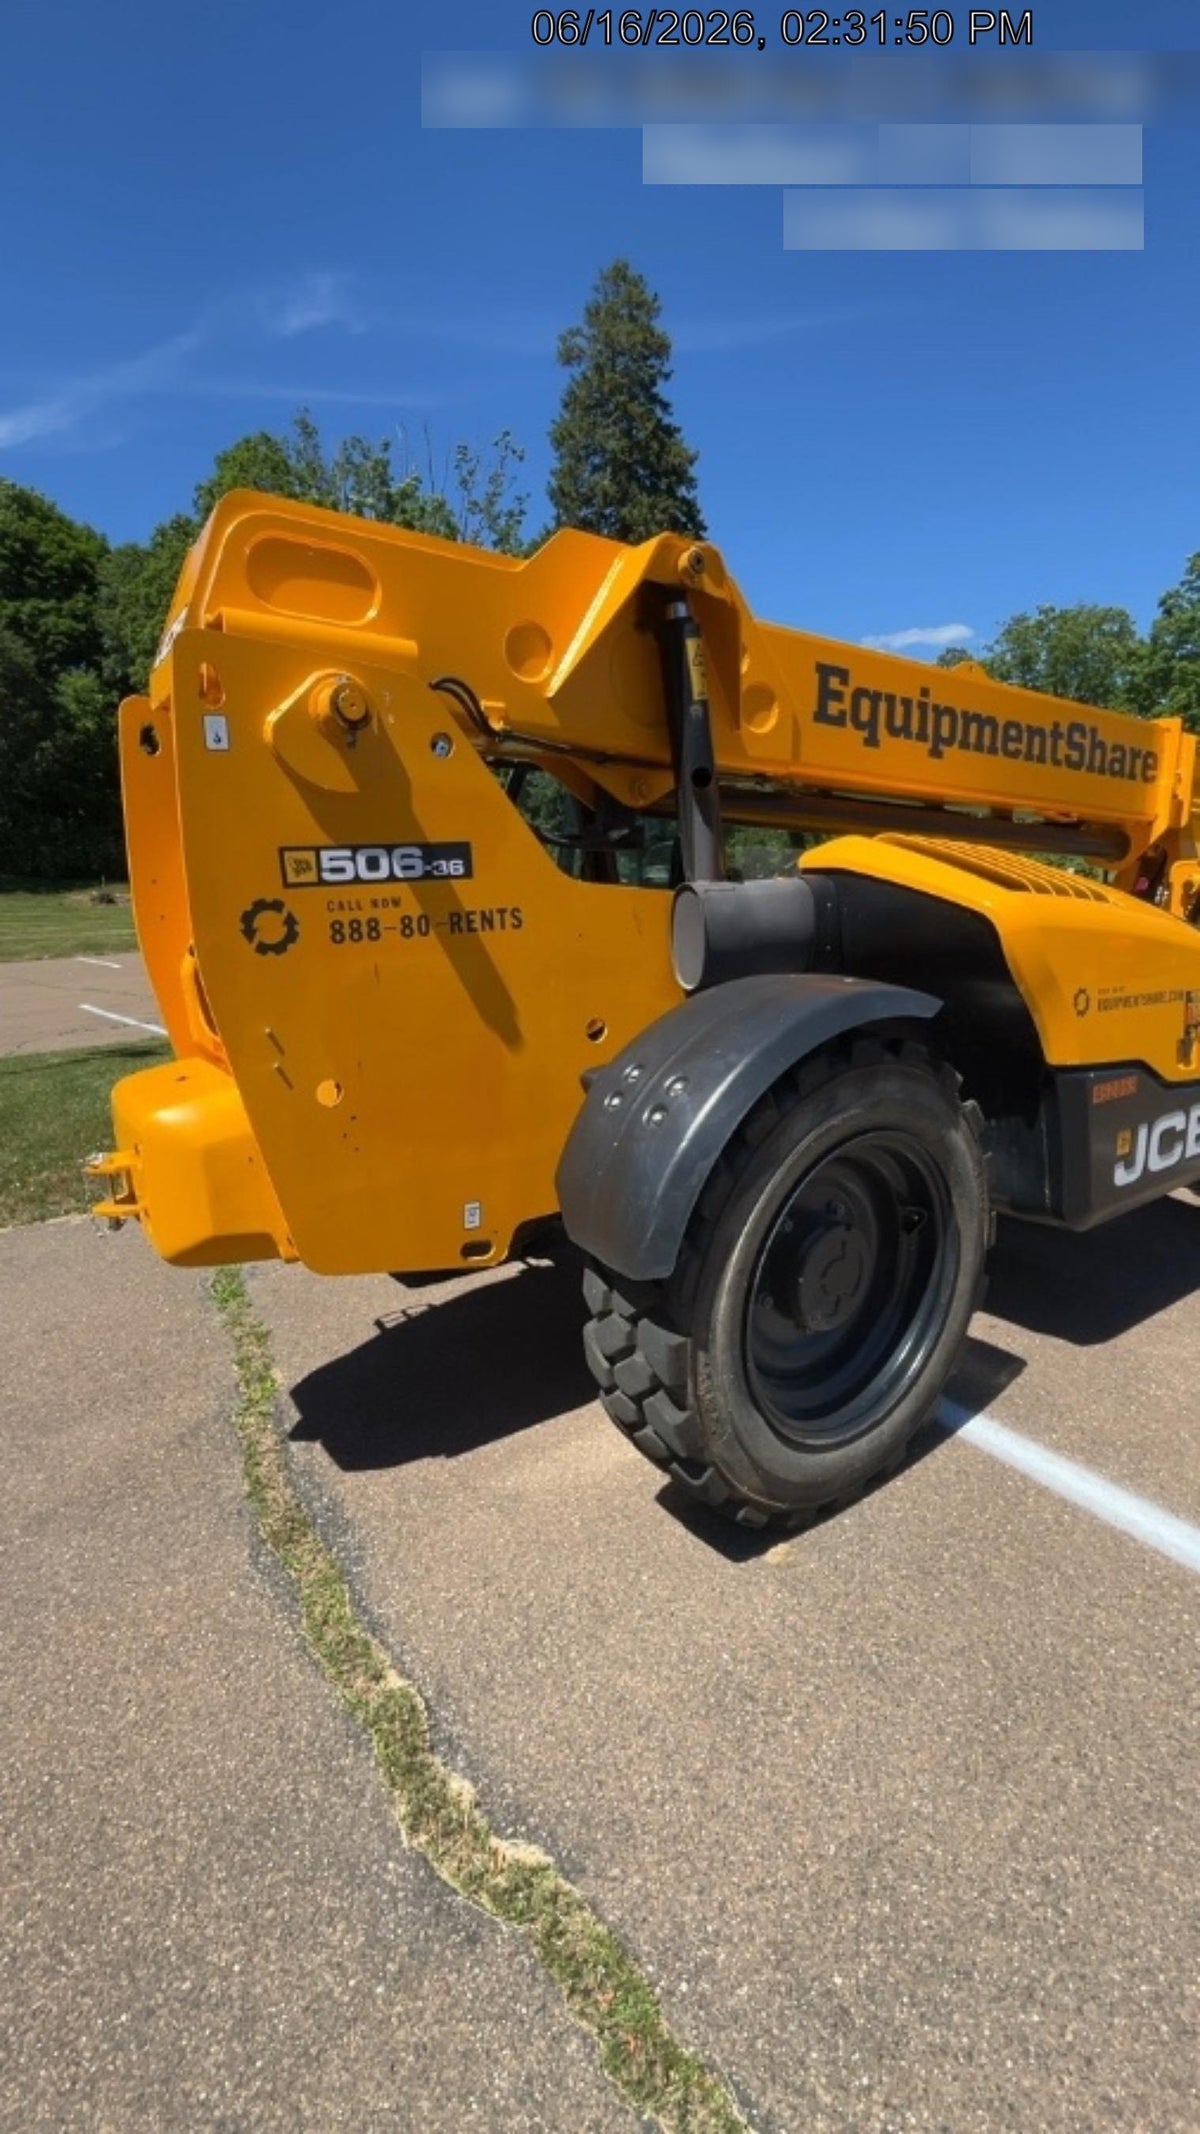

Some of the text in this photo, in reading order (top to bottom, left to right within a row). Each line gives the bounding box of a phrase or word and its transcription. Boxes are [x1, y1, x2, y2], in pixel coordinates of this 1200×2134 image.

[813, 661, 1159, 783] EquipmentShare
[319, 846, 465, 882] 506-36
[327, 899, 364, 913] CALL
[329, 907, 524, 945] 888-80-RENTS
